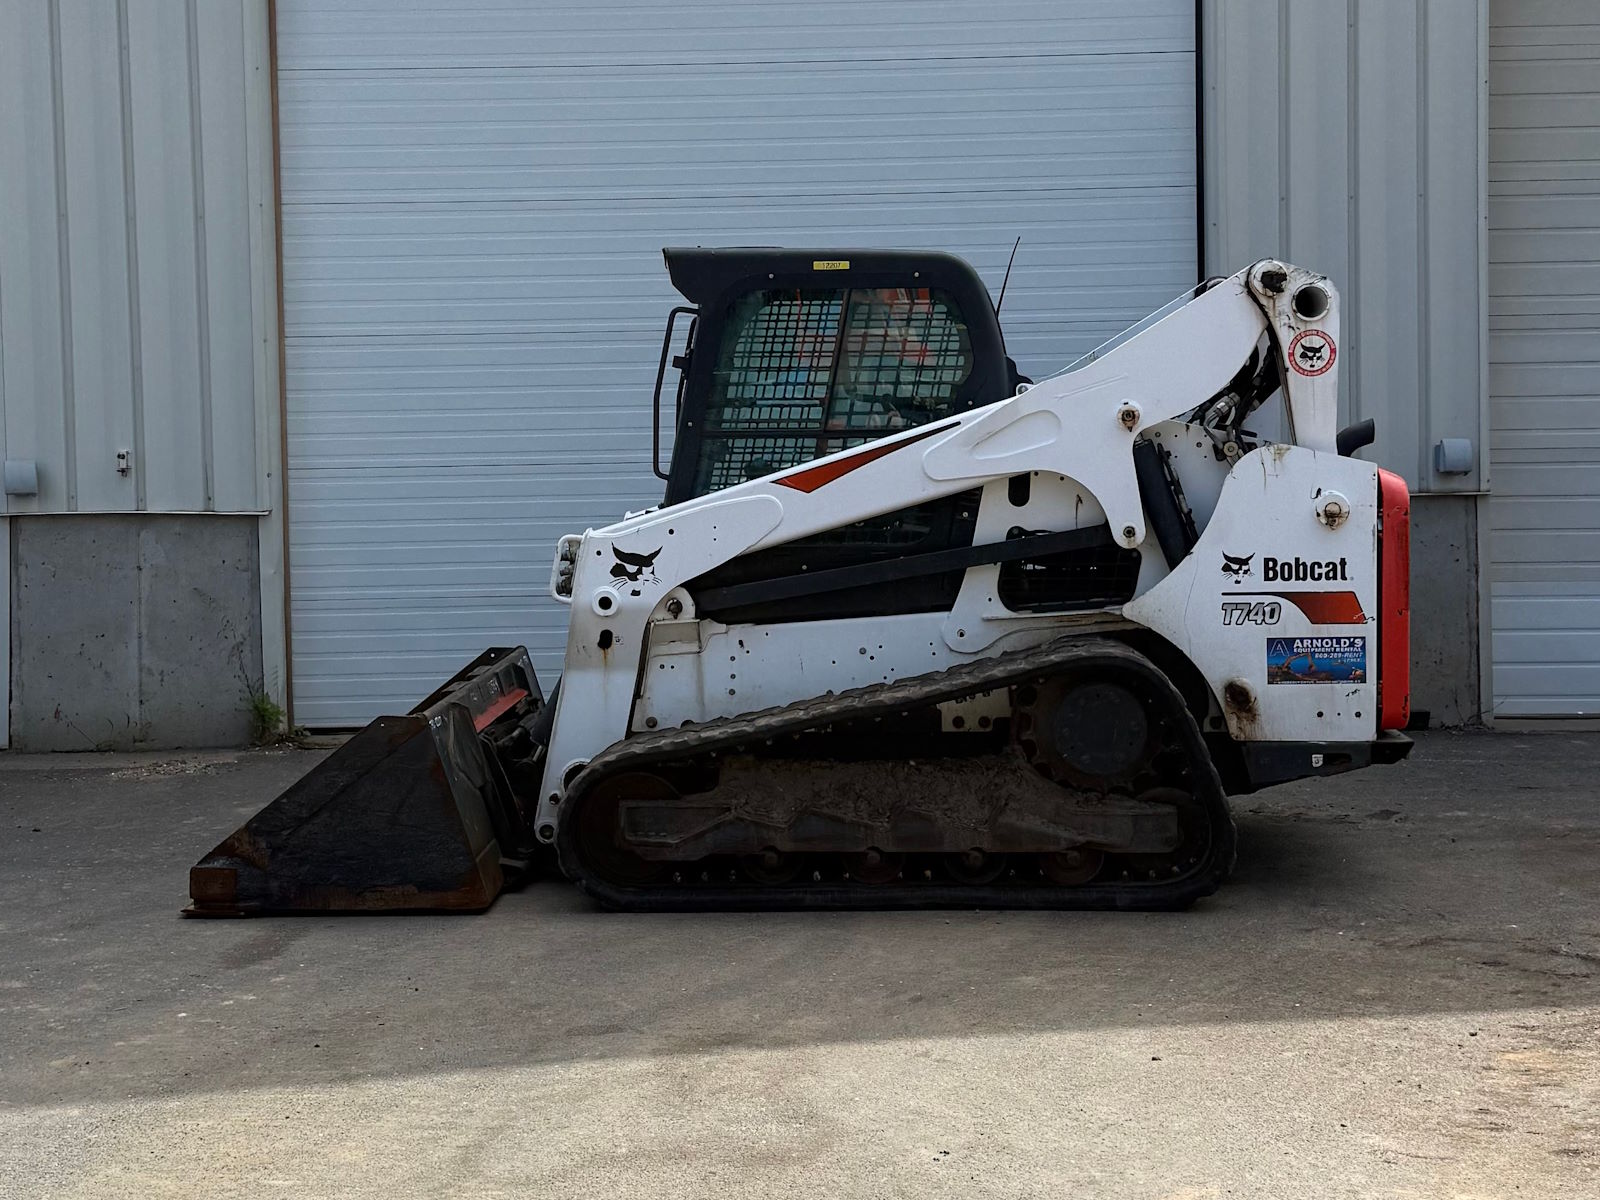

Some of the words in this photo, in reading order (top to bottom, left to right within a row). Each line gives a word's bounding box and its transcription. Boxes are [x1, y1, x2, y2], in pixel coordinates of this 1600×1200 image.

[1263, 557, 1348, 581] Bobcat
[1221, 602, 1281, 625] T740
[1294, 638, 1363, 648] ARNOLD'S
